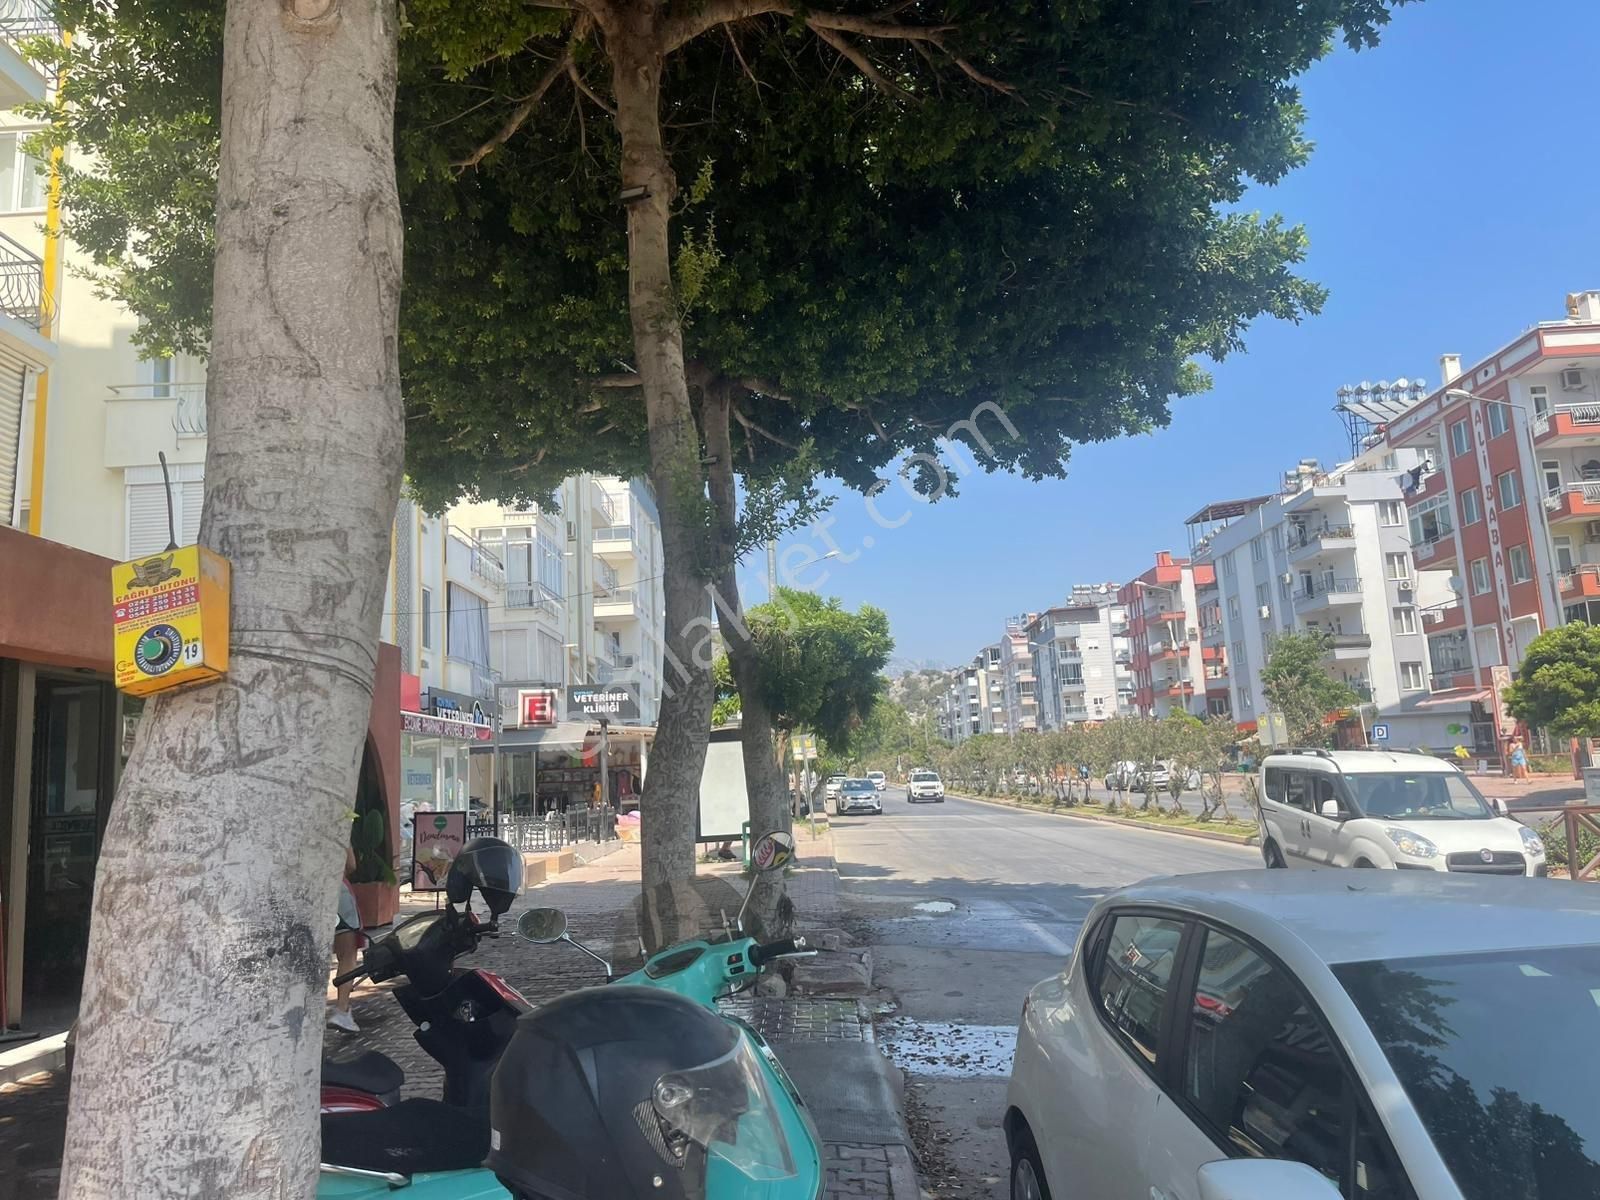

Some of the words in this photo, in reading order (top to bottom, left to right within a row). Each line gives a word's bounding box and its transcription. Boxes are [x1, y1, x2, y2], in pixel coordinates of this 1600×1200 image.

[1485, 484, 1503, 569] BABA
[115, 589, 149, 604] ÇAĞRI
[152, 577, 197, 593] BUTONU
[128, 598, 150, 608] 0242
[152, 593, 168, 602] 259
[128, 604, 150, 613] 0242
[152, 599, 169, 607] 259
[128, 609, 150, 619] 0541
[153, 604, 169, 613] 259
[184, 644, 198, 660] 19
[574, 691, 629, 703] VETERİNER
[583, 702, 619, 714] KLİNİĞİ
[1377, 728, 1385, 737] D
